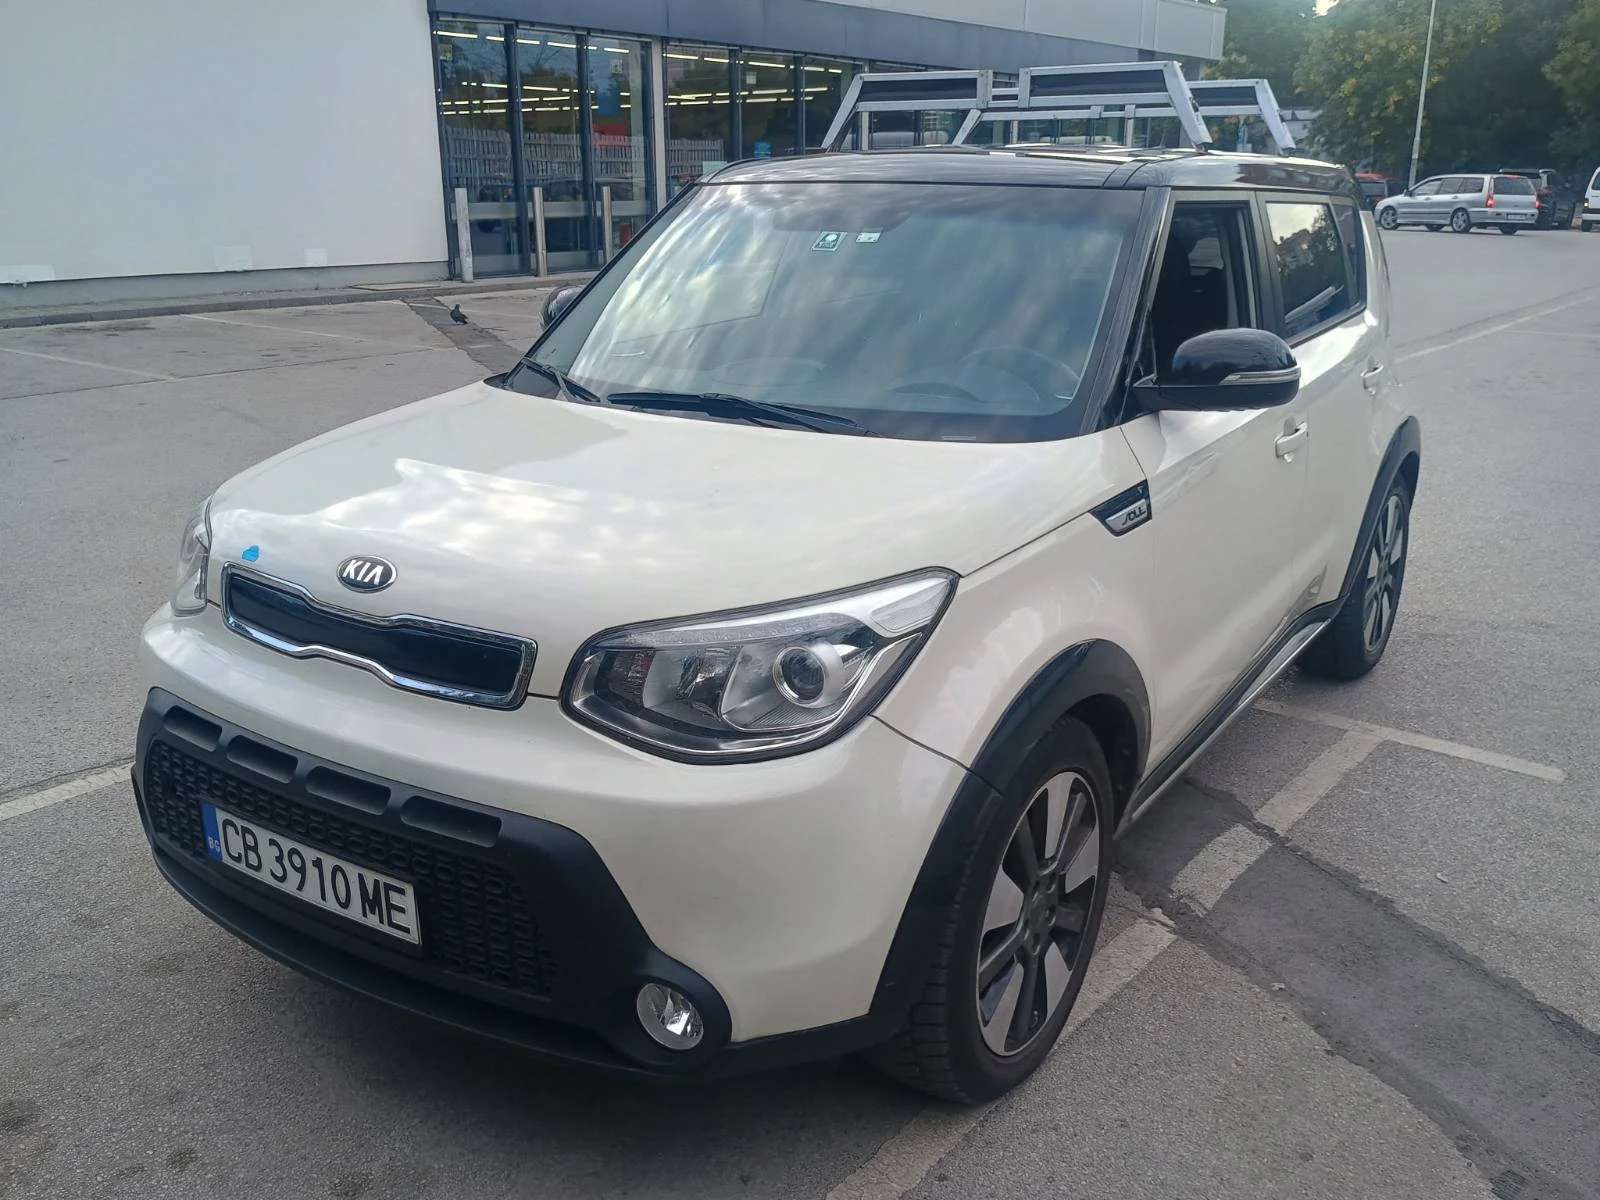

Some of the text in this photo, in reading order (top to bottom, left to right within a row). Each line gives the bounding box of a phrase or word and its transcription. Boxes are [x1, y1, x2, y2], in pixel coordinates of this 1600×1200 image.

[342, 559, 384, 586] KIA
[207, 835, 221, 852] BG
[222, 818, 411, 934] CB 3910 ME
